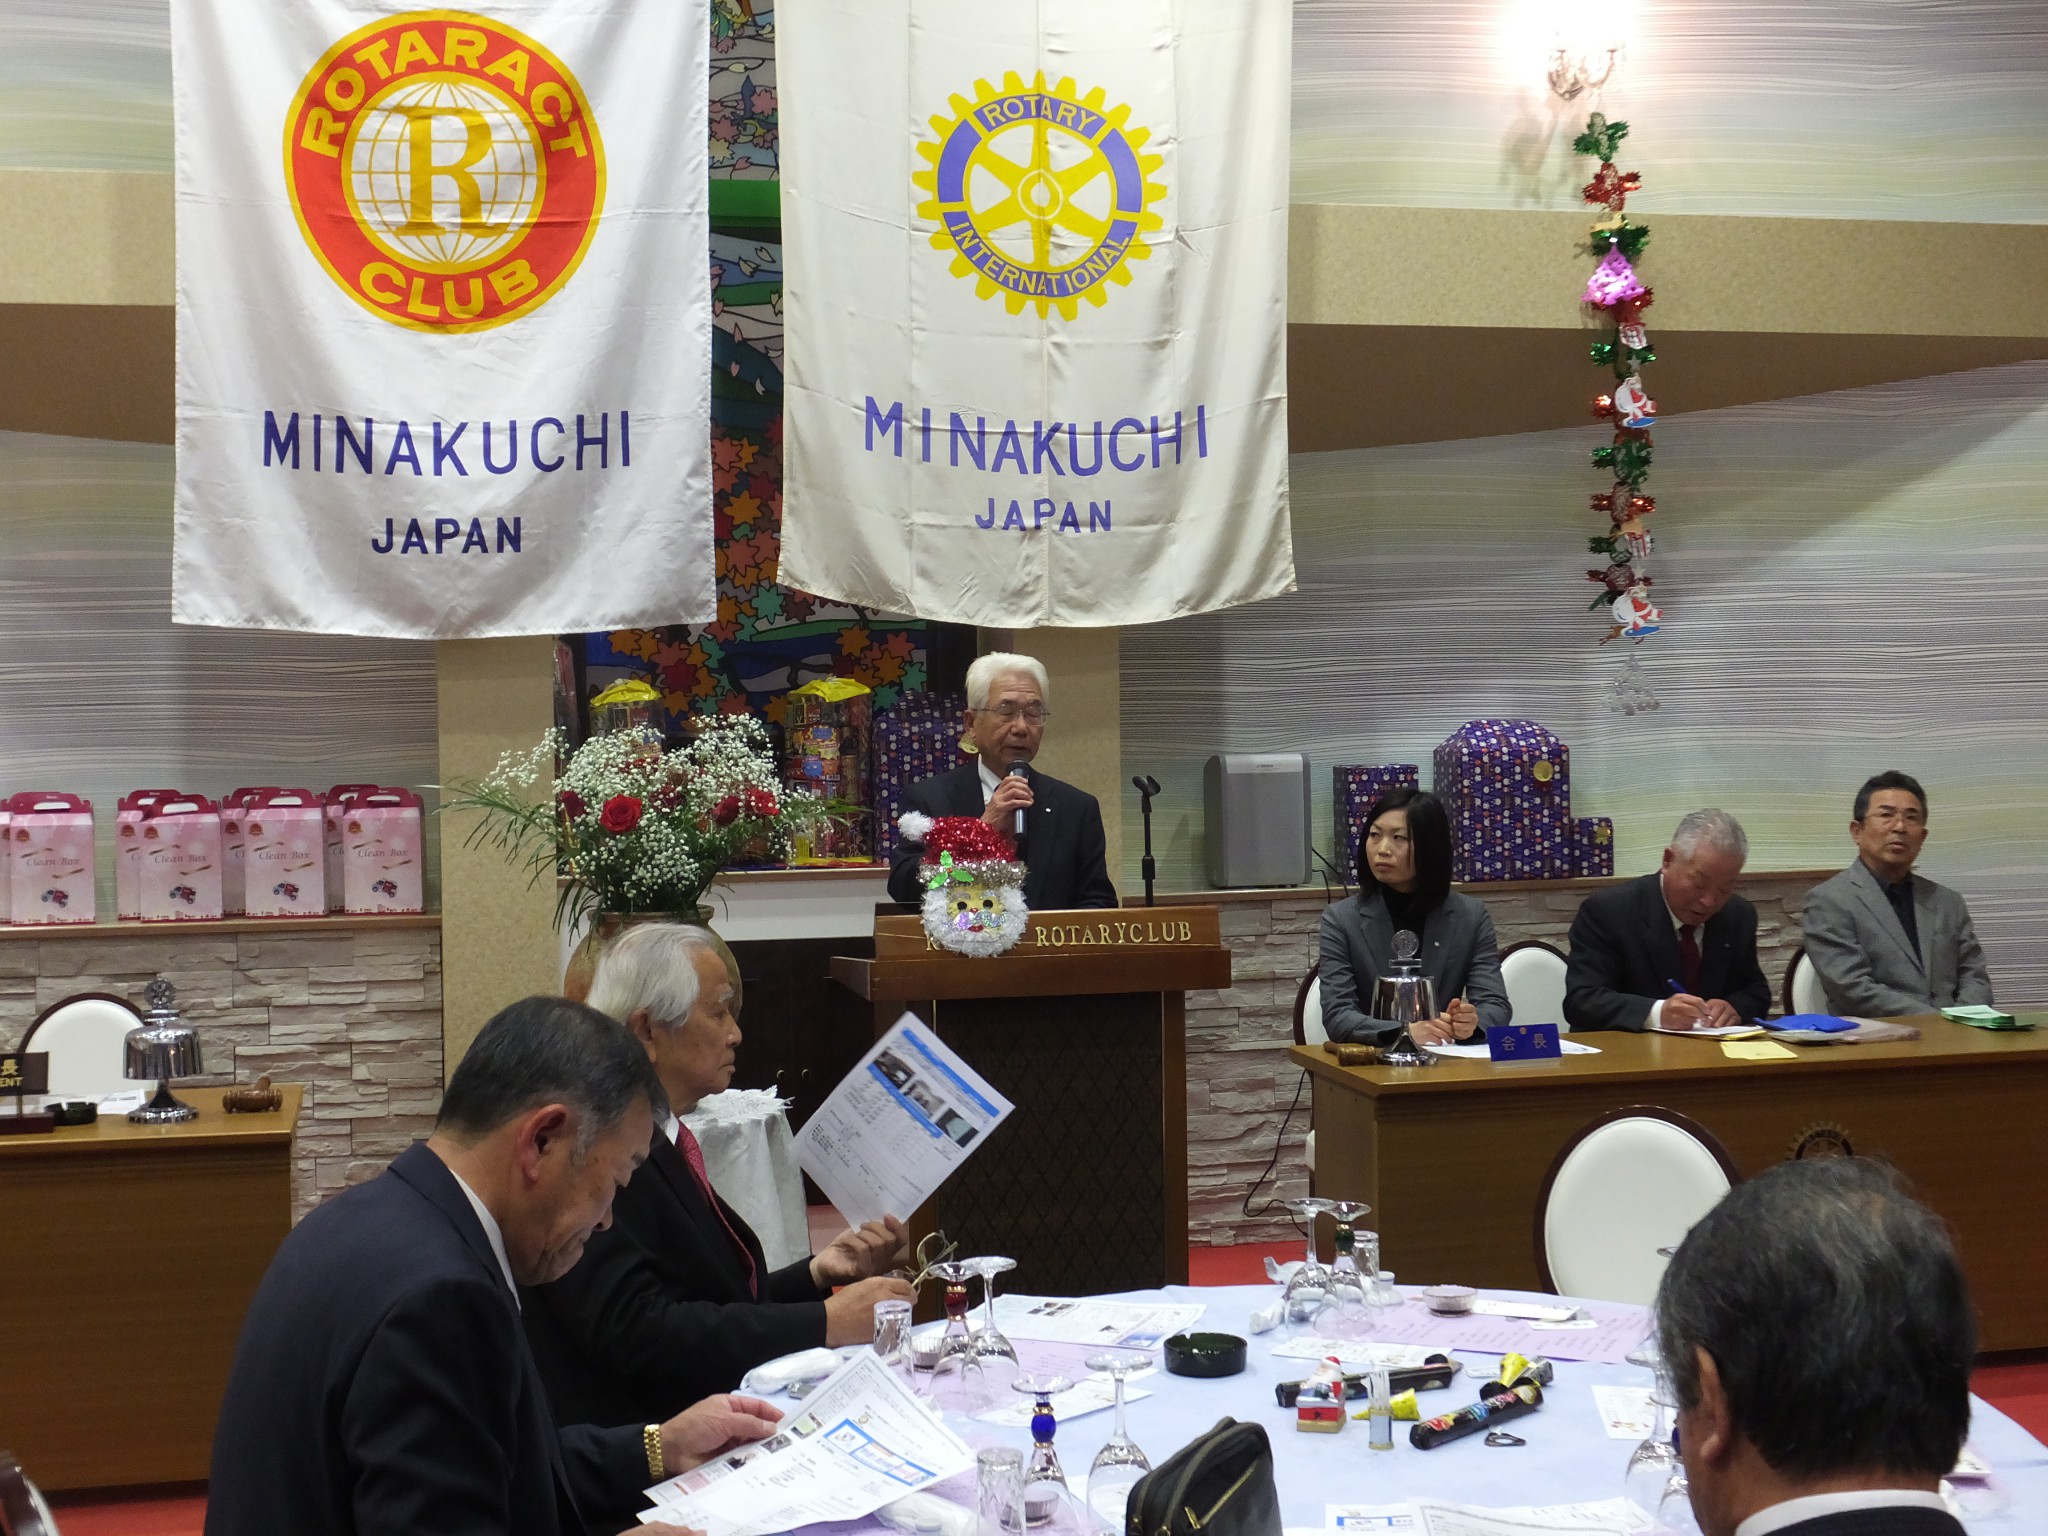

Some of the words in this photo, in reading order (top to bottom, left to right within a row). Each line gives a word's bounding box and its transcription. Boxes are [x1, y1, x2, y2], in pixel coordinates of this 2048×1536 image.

[300, 27, 588, 159] ROTARACT
[984, 94, 1098, 133] ROTARY
[390, 105, 510, 238] R
[359, 258, 539, 319] CLUB
[950, 220, 1131, 296] INTERNATIONAL
[262, 410, 631, 477] MINAKUCHI
[864, 395, 1208, 477] MINAKUCHI
[371, 516, 523, 554] JAPAN
[974, 497, 1112, 533] JAPAN
